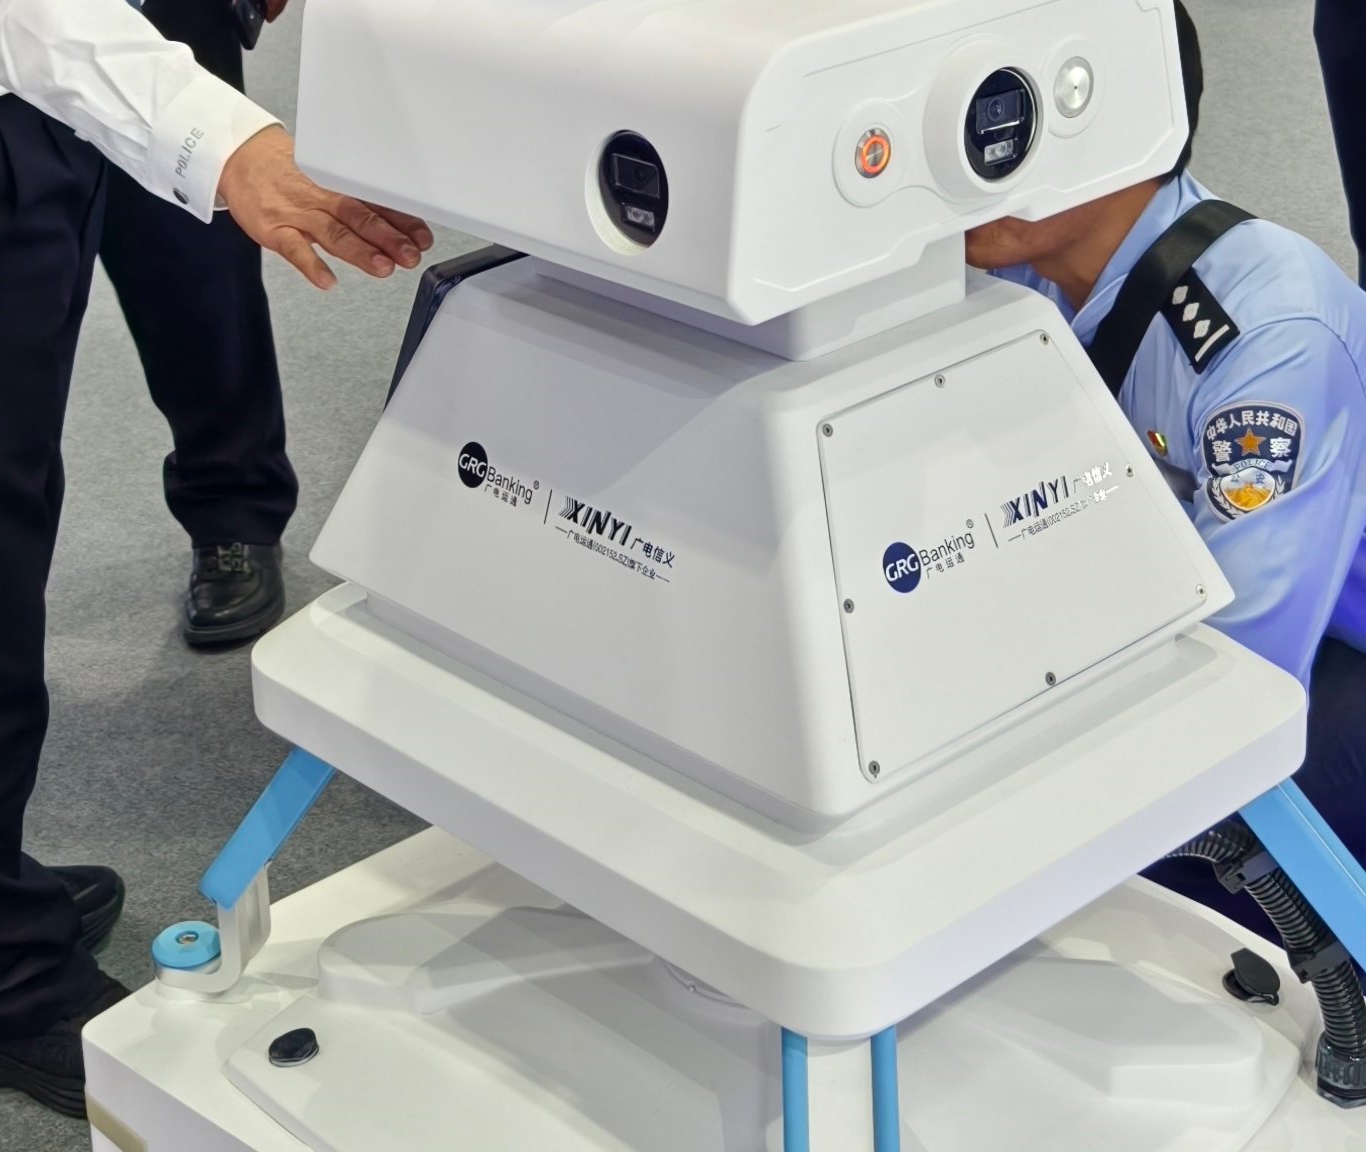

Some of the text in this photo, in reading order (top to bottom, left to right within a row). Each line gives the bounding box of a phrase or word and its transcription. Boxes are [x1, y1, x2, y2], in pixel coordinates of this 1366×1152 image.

[1206, 410, 1298, 440] 中华人民共和国
[458, 453, 533, 504] GRG Banking
[1008, 476, 1070, 525] XINYI
[565, 498, 633, 546] XINYI
[630, 537, 675, 568] 广电信义
[885, 532, 975, 582] GRG Banking
[926, 552, 965, 579] 广电运通
